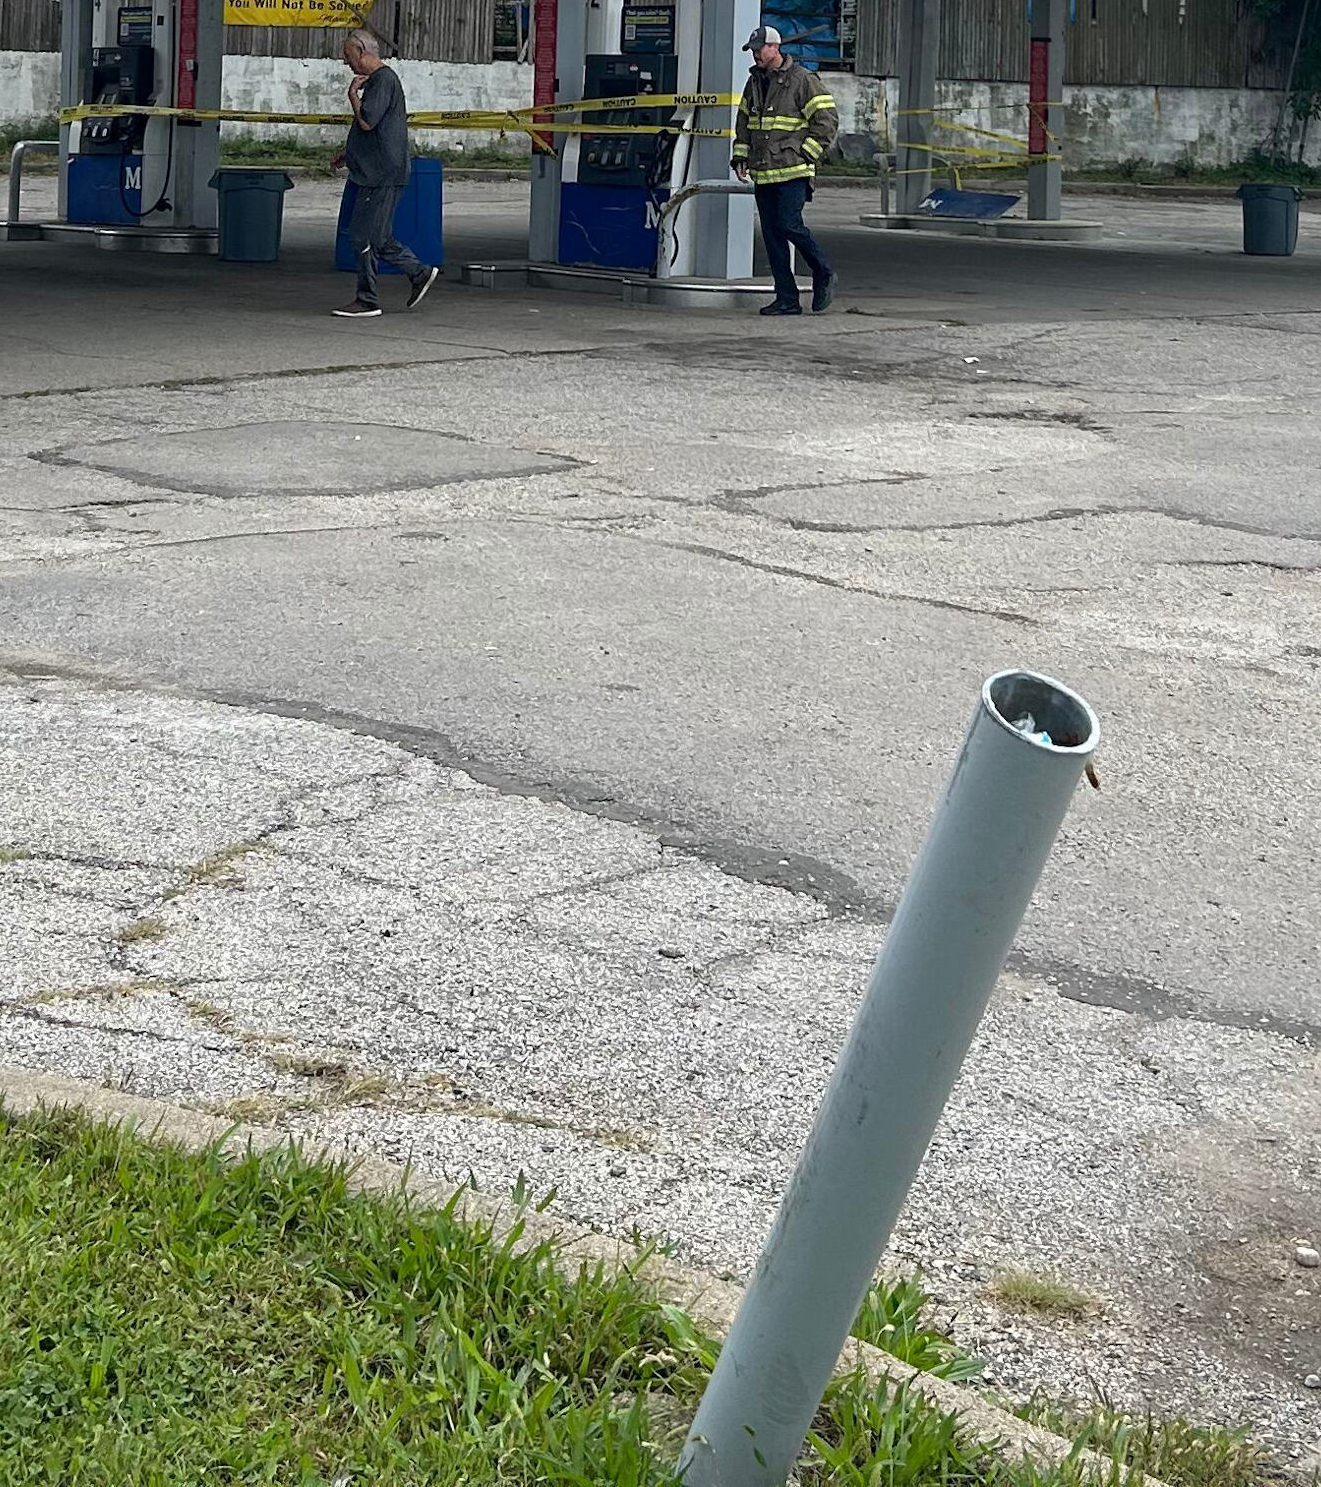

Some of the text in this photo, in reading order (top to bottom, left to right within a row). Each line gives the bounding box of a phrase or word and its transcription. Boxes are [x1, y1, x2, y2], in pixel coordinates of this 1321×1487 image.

[255, 0, 276, 8] Will
[282, 0, 303, 9] Not
[309, 1, 324, 9] Be
[329, 1, 368, 10] Sered
[603, 98, 635, 107] CAUTION
[674, 95, 717, 104] CAUTION
[125, 166, 141, 189] M
